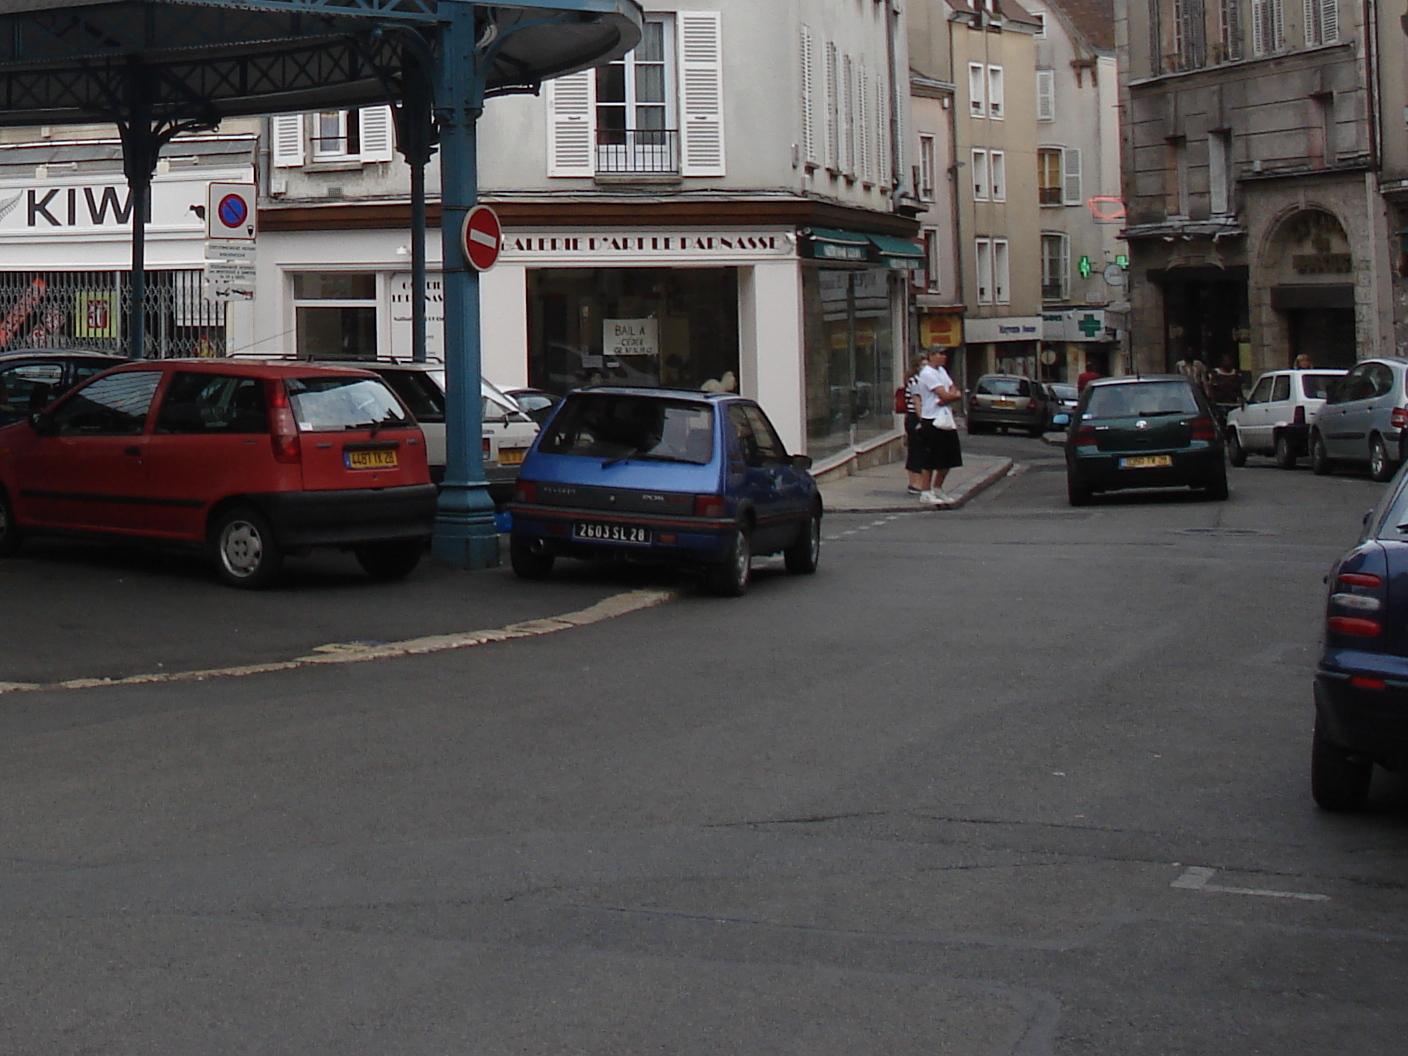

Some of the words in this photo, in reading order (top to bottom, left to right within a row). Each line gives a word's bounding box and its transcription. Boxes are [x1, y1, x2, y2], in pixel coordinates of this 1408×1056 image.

[27, 186, 152, 226] KIWI
[500, 237, 583, 252] GALERIE
[651, 236, 675, 251] LE
[679, 236, 780, 251] PARNASSE
[579, 523, 610, 539] 2603
[612, 526, 627, 541] SL
[629, 528, 645, 542] 28
